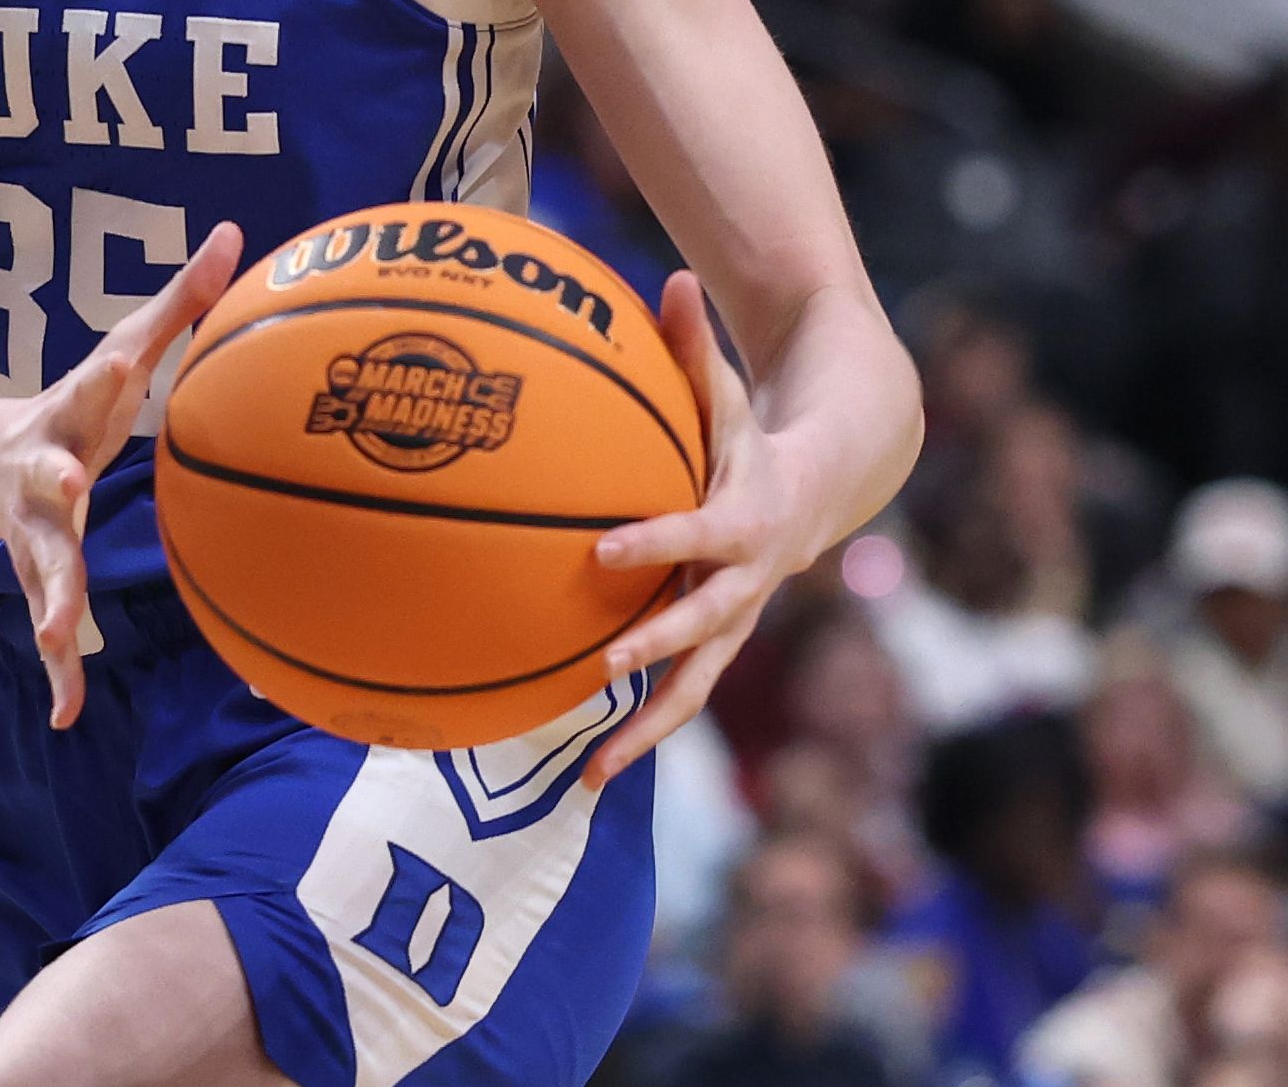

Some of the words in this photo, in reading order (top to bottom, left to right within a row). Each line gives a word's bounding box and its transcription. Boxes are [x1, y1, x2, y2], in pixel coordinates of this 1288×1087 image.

[267, 218, 615, 343] Wilson
[357, 361, 466, 403] MARCH
[365, 391, 512, 441] MADNESS
[352, 841, 485, 1008] D
